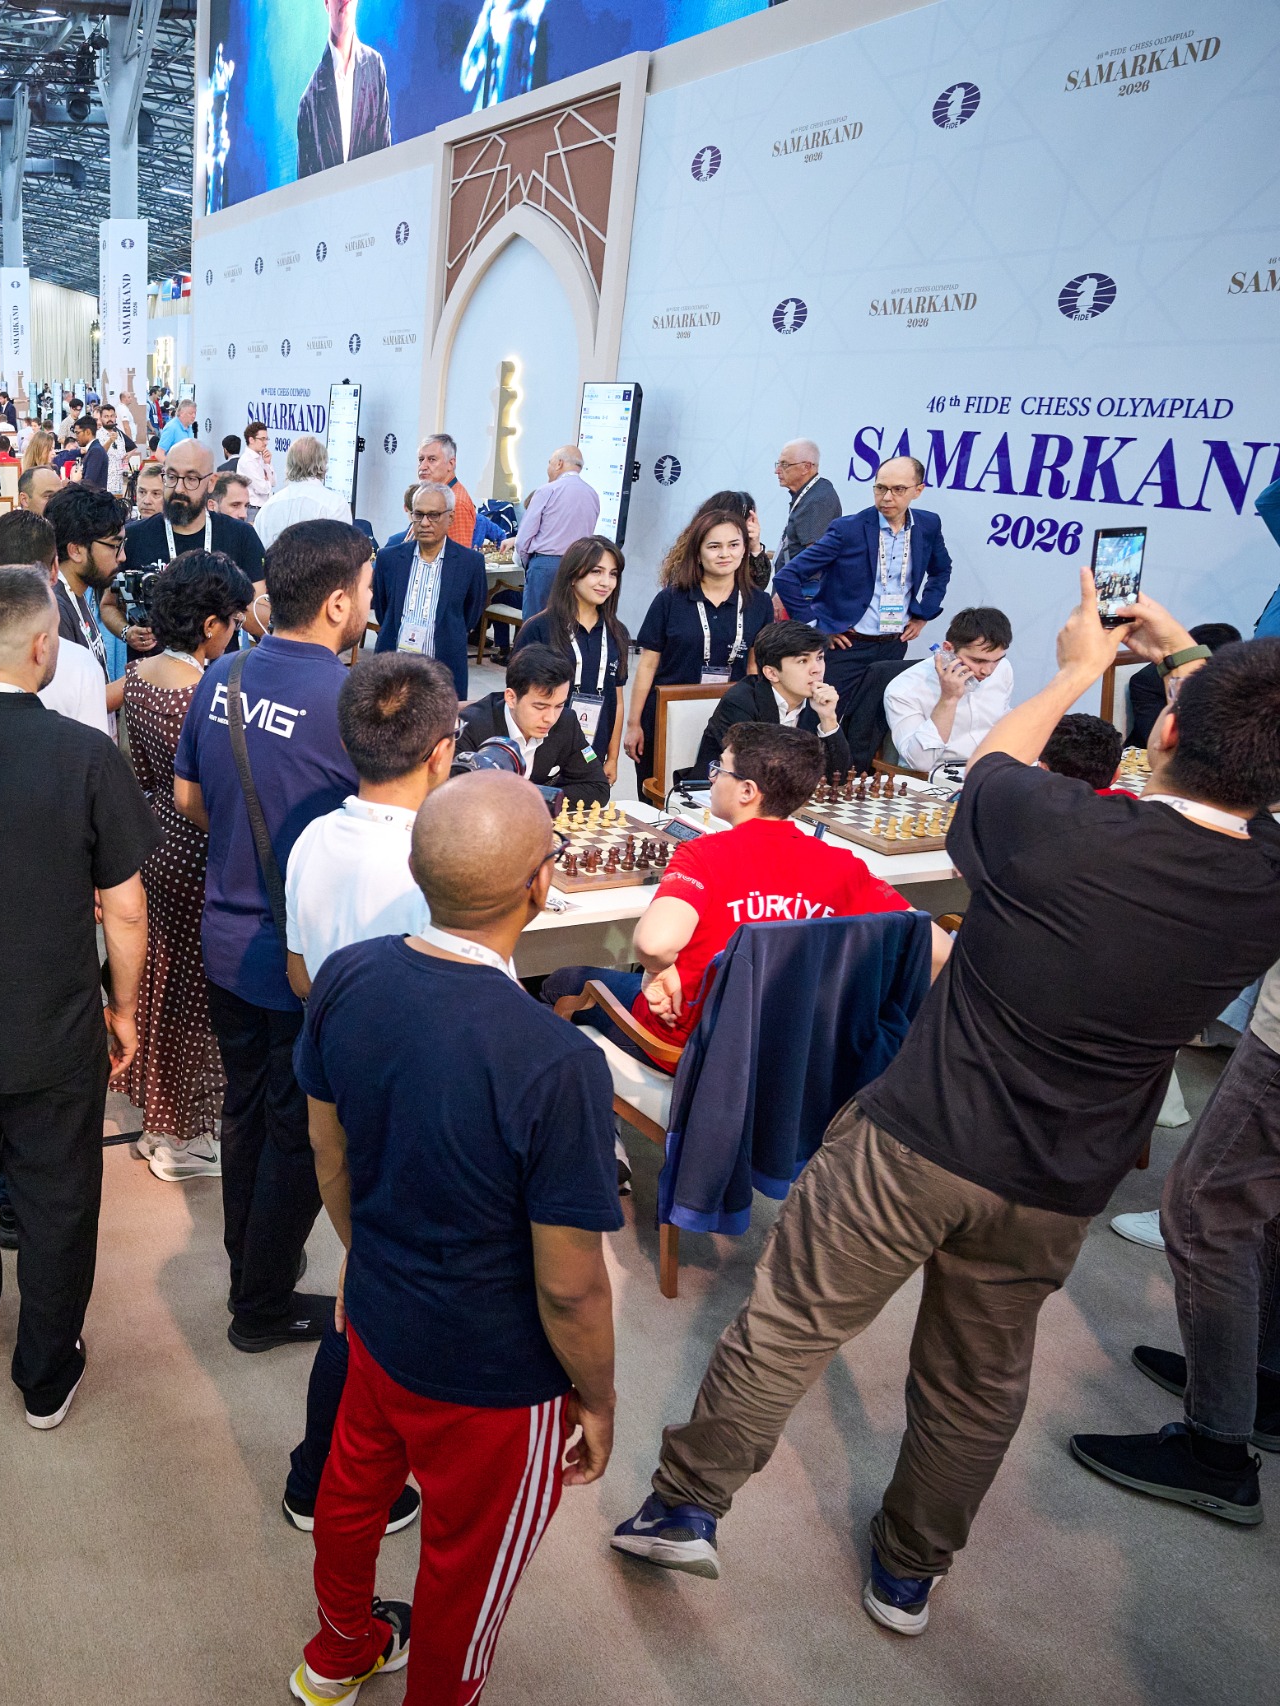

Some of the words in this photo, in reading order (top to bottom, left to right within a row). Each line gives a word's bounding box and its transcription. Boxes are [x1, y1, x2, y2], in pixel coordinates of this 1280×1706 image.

[1110, 46, 1127, 57] FIDE
[1129, 40, 1153, 52] CHESS
[1154, 30, 1194, 46] OLYMPIAD
[1064, 36, 1221, 92] SAMARKAND
[1117, 79, 1150, 97] 2026
[945, 121, 959, 130] FIDE
[771, 121, 864, 158] SAMARKAND
[803, 151, 823, 163] 2026
[123, 273, 131, 345] SAMARKAND
[869, 292, 978, 316] SAMARKAND
[652, 311, 721, 329] SAMARKAND
[906, 318, 929, 328] 2026
[1073, 313, 1089, 321] FIDE
[248, 401, 326, 433] SAMARKAND
[964, 396, 1012, 414] FIDE
[1020, 396, 1091, 417] CHESS
[1096, 397, 1234, 419] OLYMPIAD
[987, 513, 1083, 555] 2026
